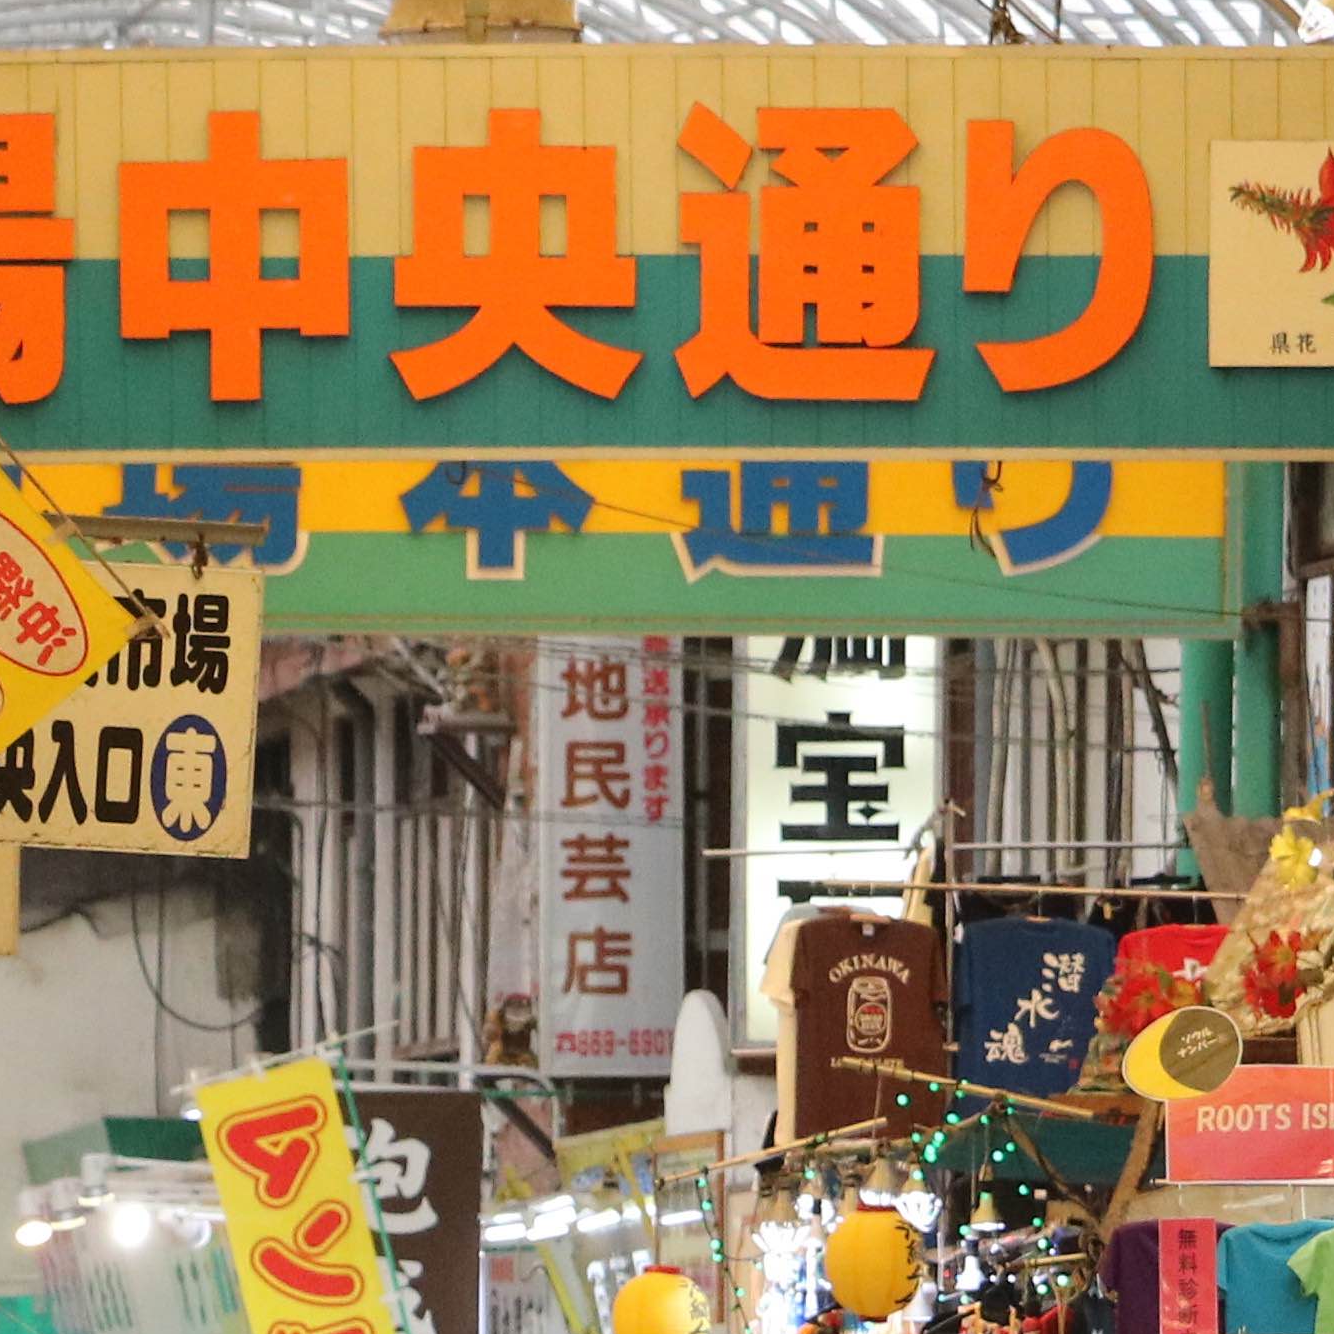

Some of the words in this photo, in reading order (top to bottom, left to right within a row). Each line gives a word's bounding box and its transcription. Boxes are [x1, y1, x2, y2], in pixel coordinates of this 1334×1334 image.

[1269, 331, 1317, 354] 県花
[84, 588, 230, 695] 市場
[163, 725, 219, 834] 東
[560, 655, 633, 997] 地民芸店
[828, 953, 910, 984] OKINAWA
[983, 952, 1086, 1064] 潜水魂
[1196, 1103, 1292, 1133] ROOTS
